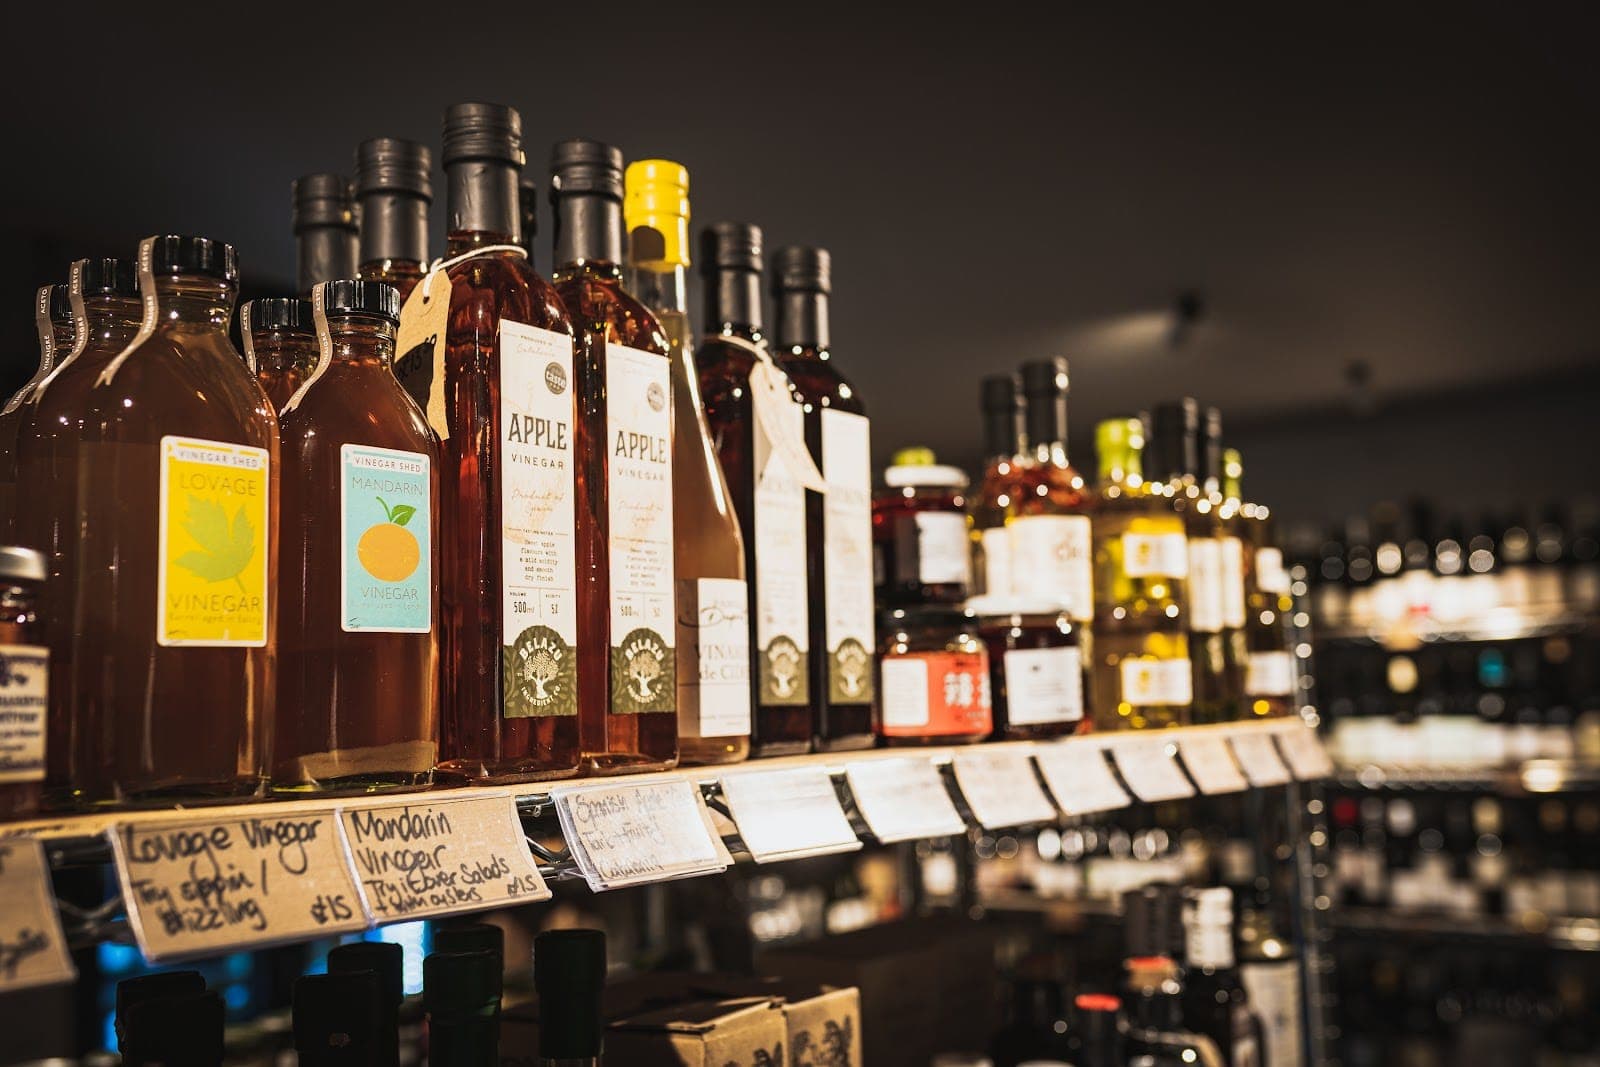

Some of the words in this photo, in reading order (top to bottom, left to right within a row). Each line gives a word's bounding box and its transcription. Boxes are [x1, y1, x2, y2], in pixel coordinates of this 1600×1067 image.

[142, 243, 151, 273] ACETO
[40, 289, 48, 314] ACETO
[42, 334, 52, 371] VINAIGRE
[508, 412, 567, 450] APPLE
[179, 449, 228, 463] VINEGAR
[232, 456, 258, 468] SHED
[615, 430, 666, 464] APPLE
[354, 457, 395, 469] VINEGAR
[399, 462, 421, 473] SHED
[511, 453, 564, 469] VINEGAR
[179, 472, 257, 496] LOVAGE
[618, 467, 665, 481] VINEGAR
[352, 477, 422, 496] MANDARIN
[168, 594, 262, 612] VINEGAR
[361, 587, 419, 601] VINEGAR
[519, 637, 563, 661] BELAZU
[625, 638, 664, 661] BELAZU
[351, 806, 452, 843] Mandarin
[126, 825, 232, 872] Lovage
[241, 819, 323, 875] Vinegar
[460, 854, 511, 884] Salads
[430, 886, 482, 906] oysters
